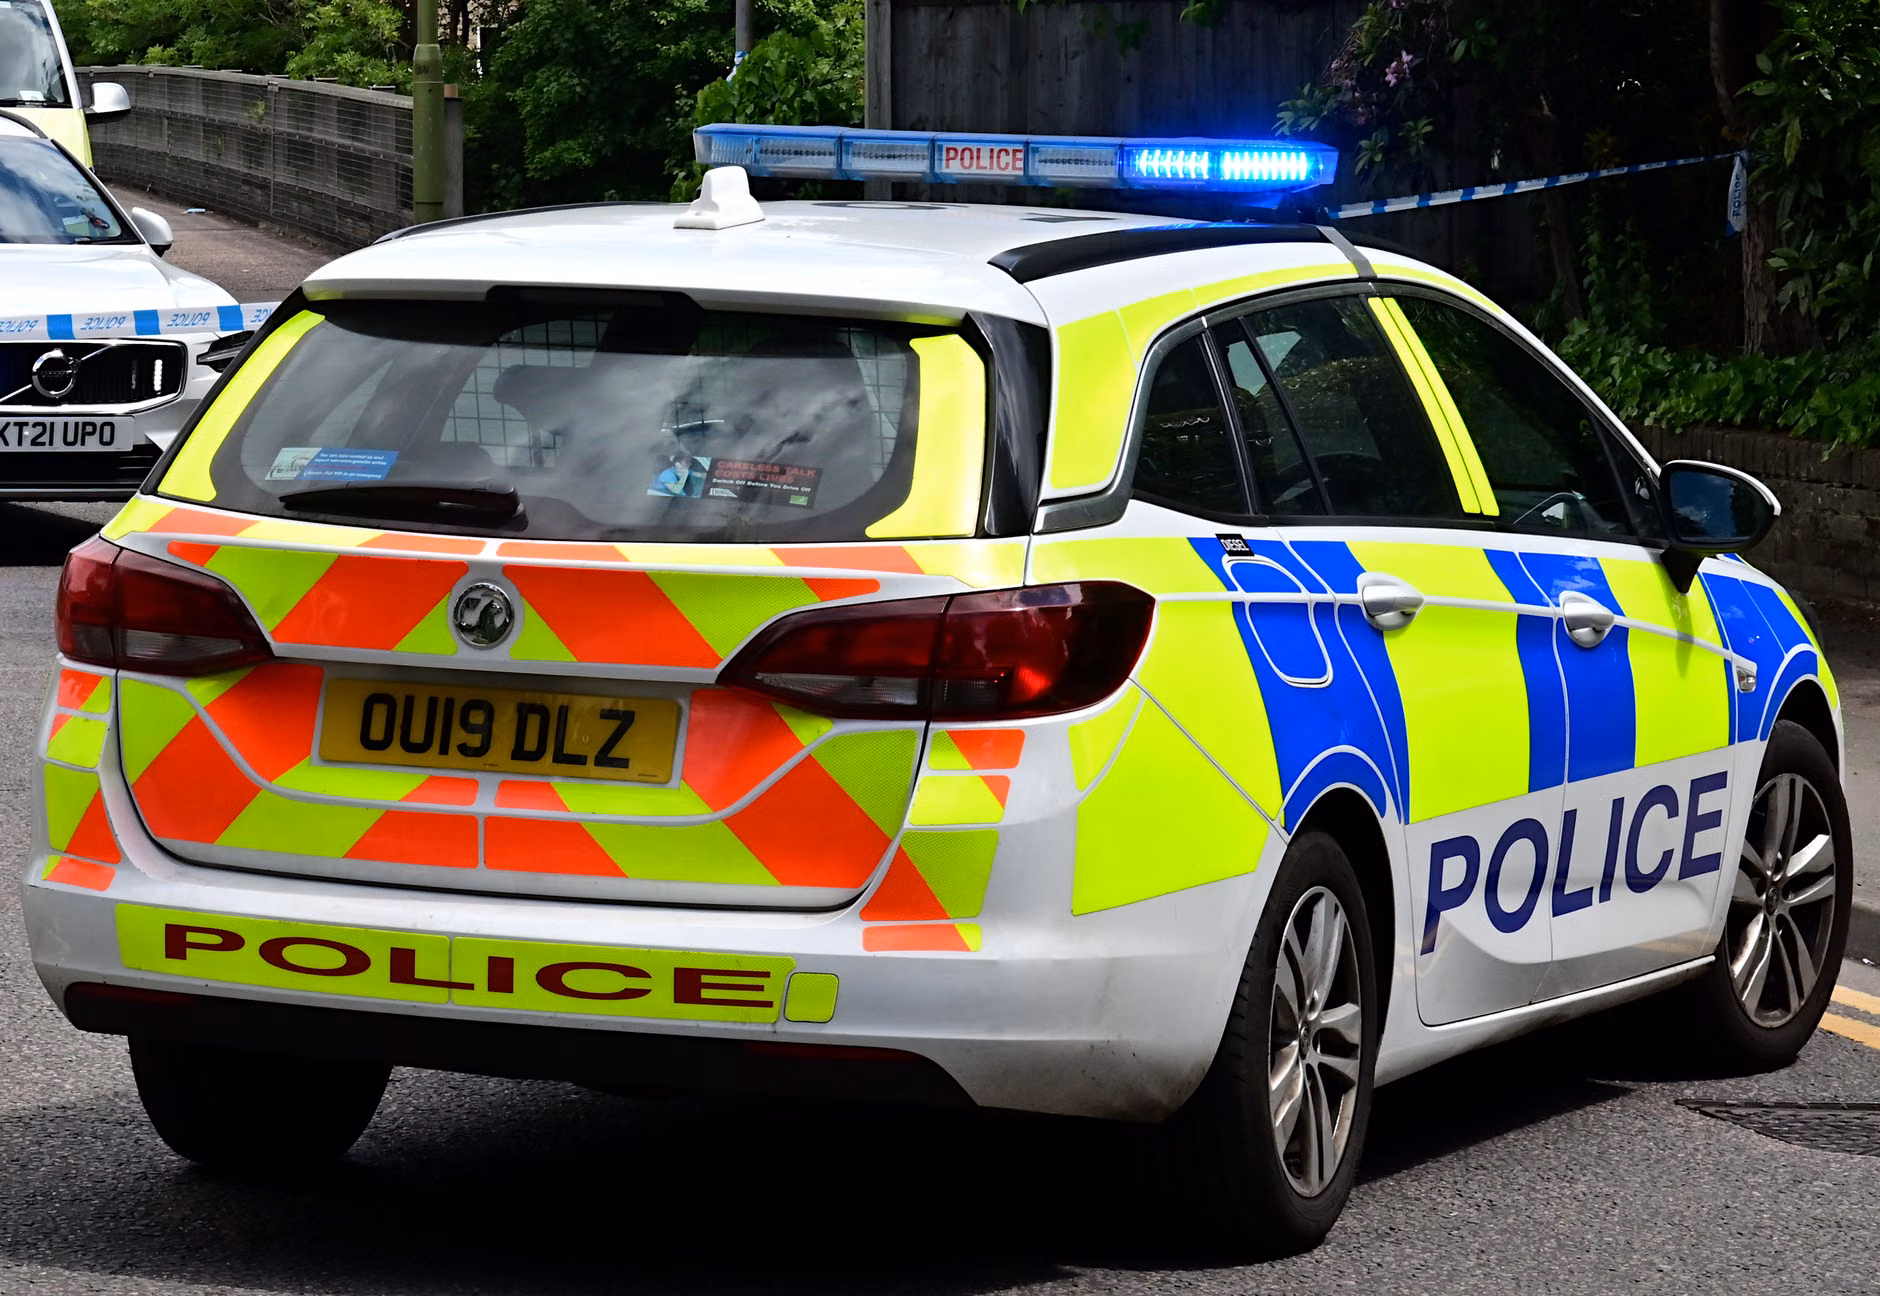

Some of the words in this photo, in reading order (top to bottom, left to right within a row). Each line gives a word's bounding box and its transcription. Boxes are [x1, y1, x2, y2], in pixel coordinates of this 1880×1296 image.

[945, 146, 1024, 171] POLICE
[0, 421, 54, 446] KT21
[62, 421, 115, 446] UPO
[718, 460, 780, 472] CARELESS
[785, 466, 817, 478] TALK
[359, 692, 493, 758] OU19
[510, 701, 638, 769] DLZ
[1420, 771, 1728, 955] POLICE
[164, 924, 774, 1008] POLICE
